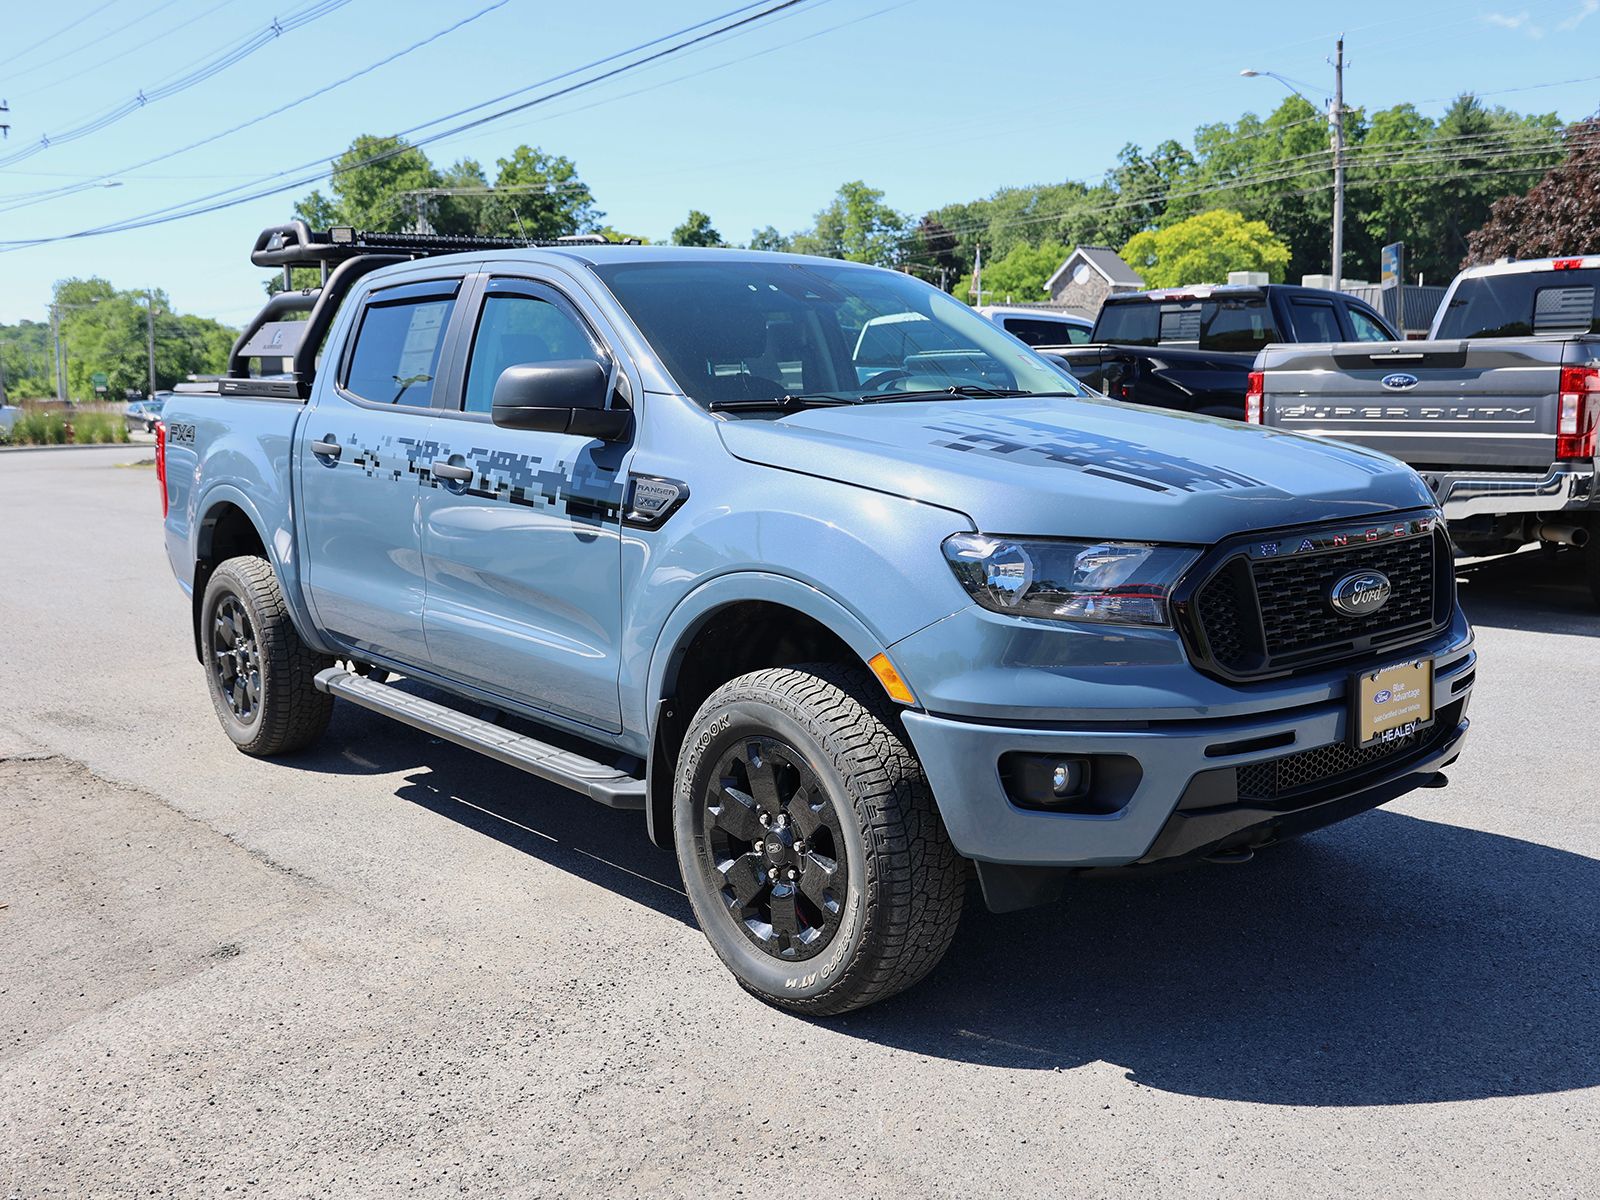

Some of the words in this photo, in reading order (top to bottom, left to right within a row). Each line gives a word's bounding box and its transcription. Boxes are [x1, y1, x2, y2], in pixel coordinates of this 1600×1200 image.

[1282, 405, 1410, 418] SUPER
[1420, 406, 1531, 418] DUTY
[168, 423, 196, 443] FX4
[637, 484, 676, 496] RANGER
[1260, 518, 1431, 557] RANGER
[1351, 578, 1384, 606] Ford
[1381, 722, 1416, 743] HEALEY
